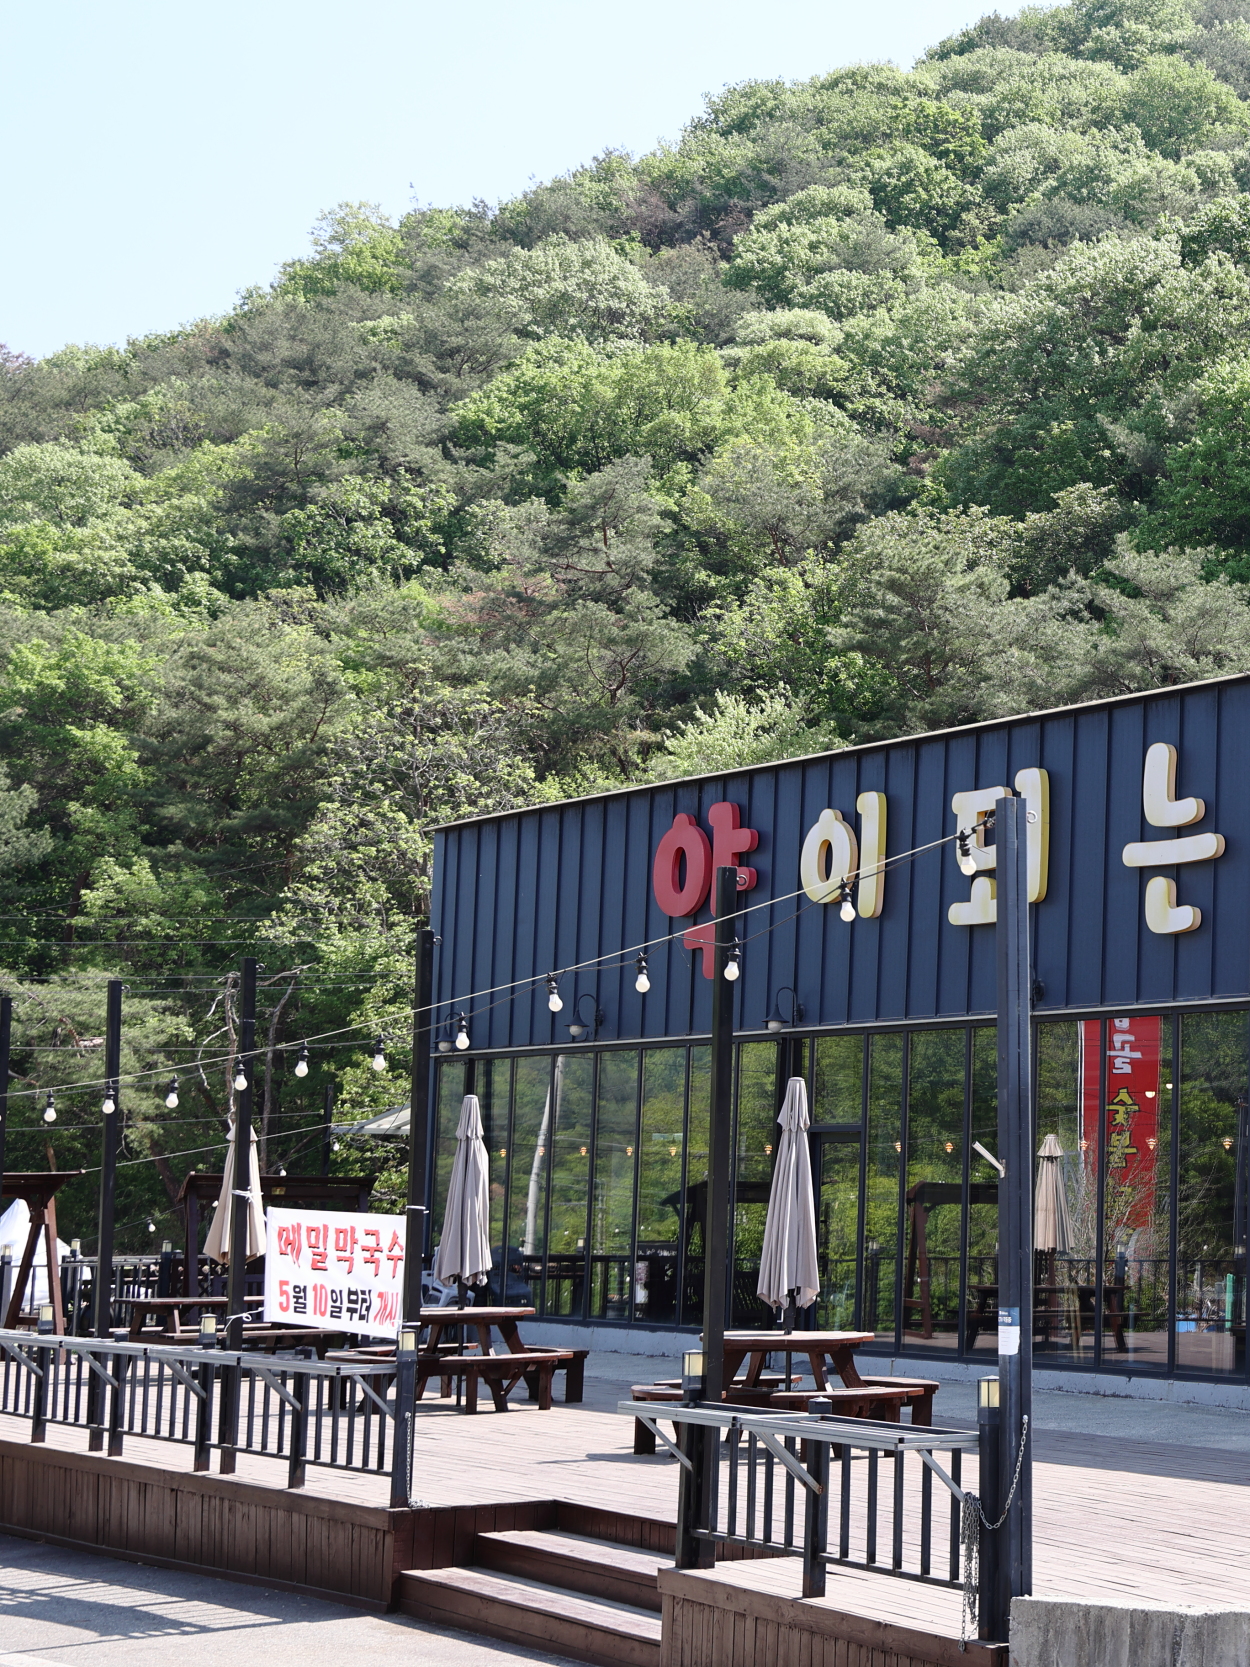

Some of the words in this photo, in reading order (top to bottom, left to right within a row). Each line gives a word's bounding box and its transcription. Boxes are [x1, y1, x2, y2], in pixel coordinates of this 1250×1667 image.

[277, 1222, 404, 1279] 메밀막국수
[278, 1280, 308, 1315] 5월
[312, 1283, 372, 1324] 10일부터
